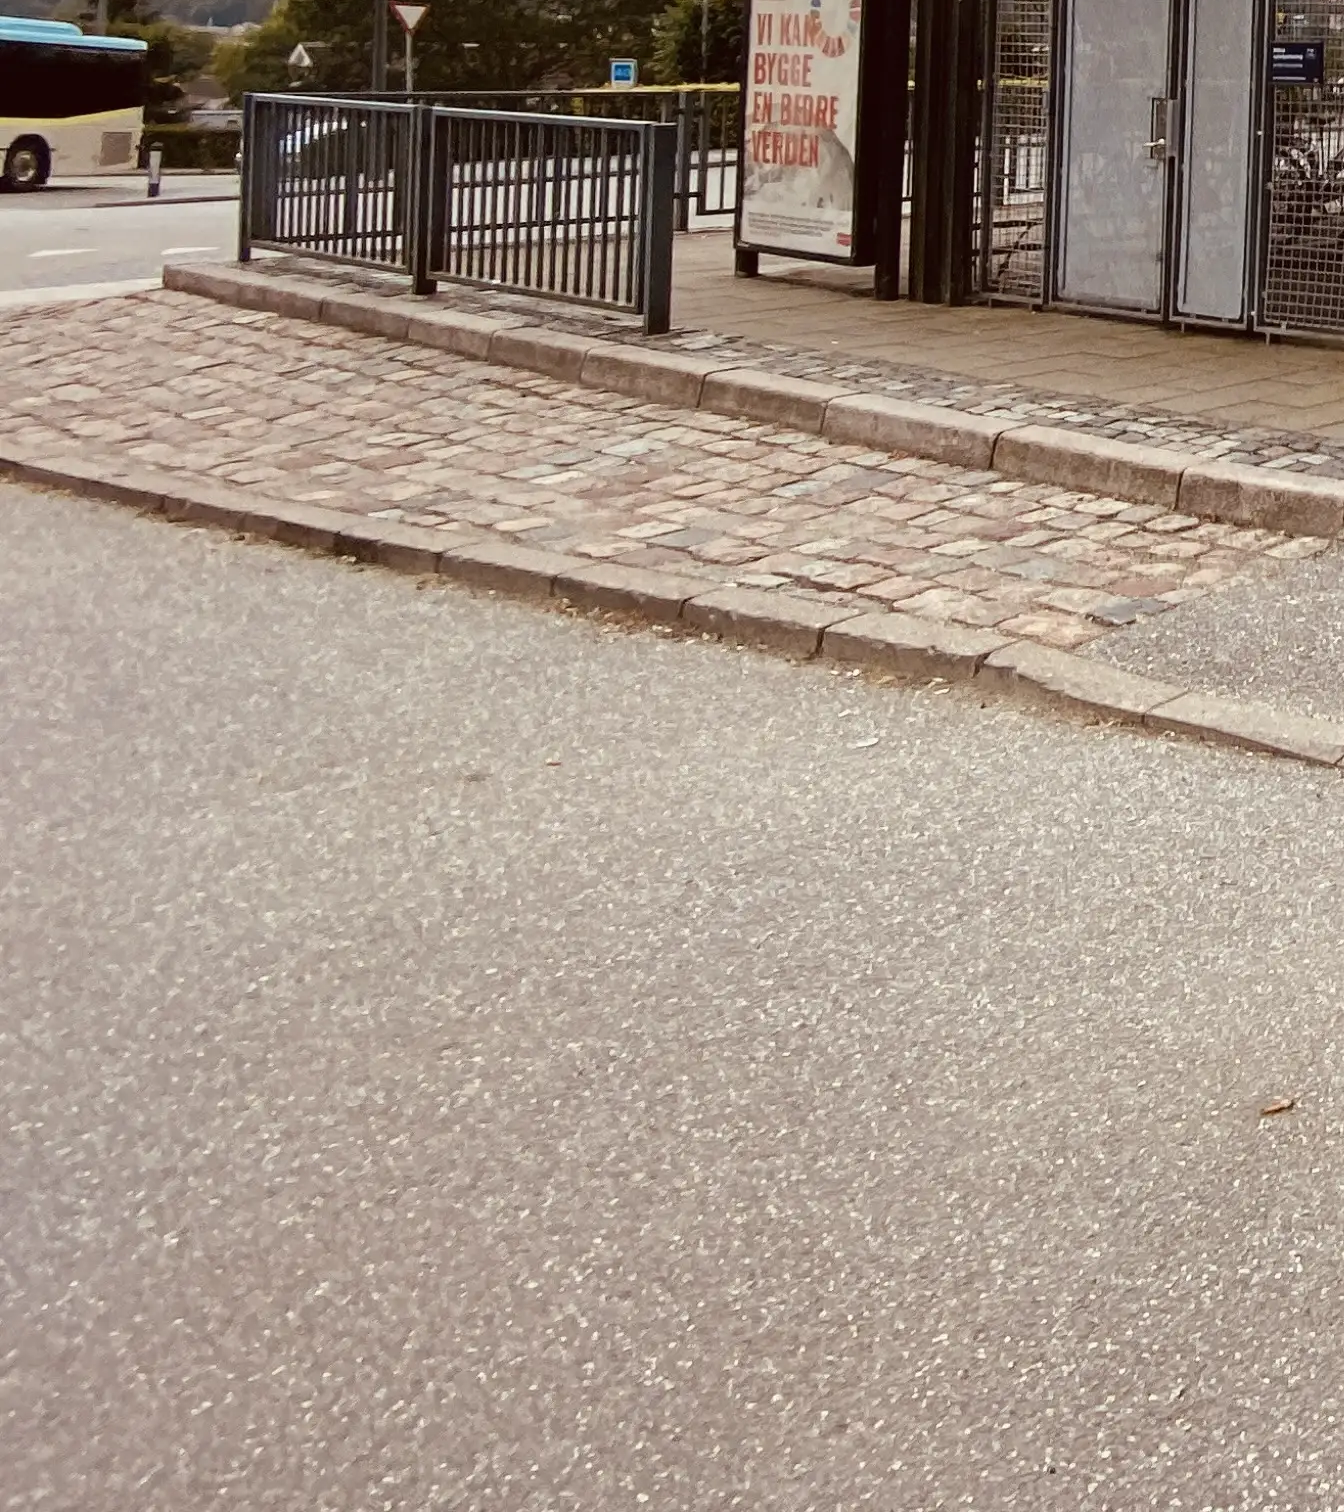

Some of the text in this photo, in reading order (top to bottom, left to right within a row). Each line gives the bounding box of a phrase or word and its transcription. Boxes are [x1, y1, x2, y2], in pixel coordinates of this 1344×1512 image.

[757, 13, 815, 47] VI KAN
[754, 52, 814, 87] BYGGE
[752, 91, 839, 129] EN BEDRE
[751, 130, 819, 168] VERDEN
